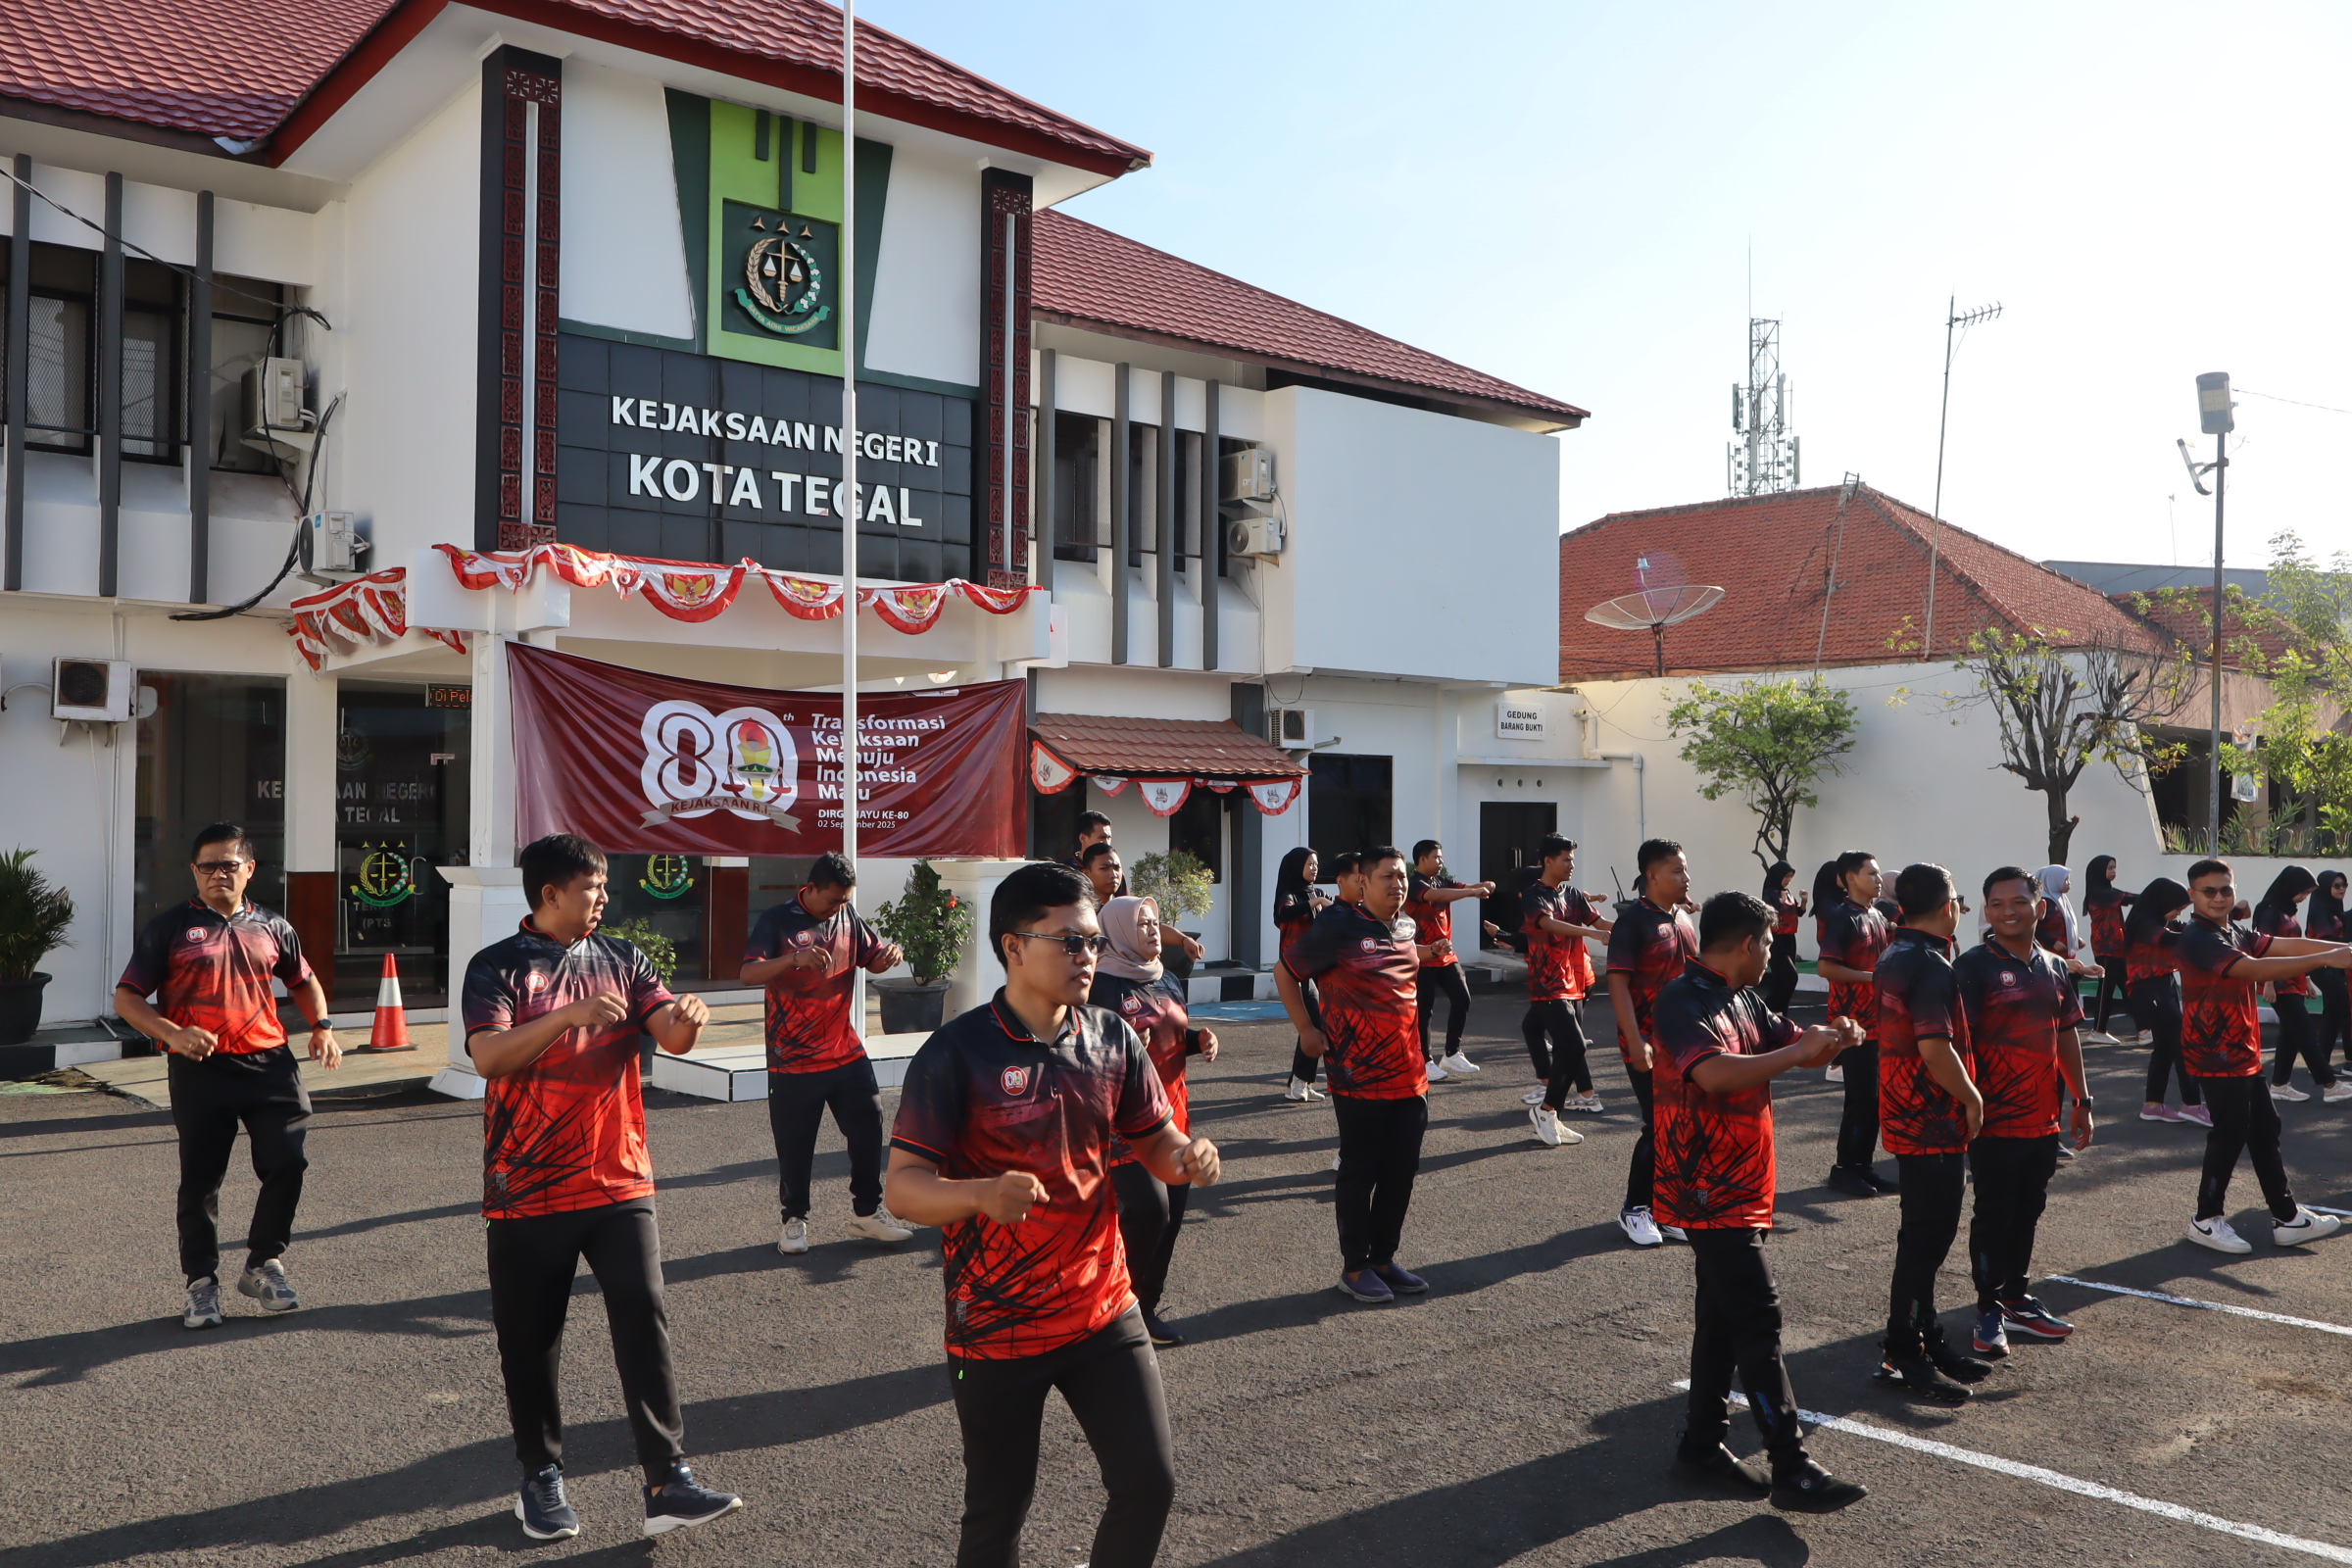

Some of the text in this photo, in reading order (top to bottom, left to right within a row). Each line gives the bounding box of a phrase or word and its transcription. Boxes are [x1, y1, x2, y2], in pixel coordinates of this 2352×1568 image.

[612, 396, 815, 451] KEJAKSAAN
[628, 454, 922, 527] KOTA TEGAL
[450, 690, 472, 703] Pel
[811, 713, 946, 730] Trasformasi
[1507, 710, 1538, 719] GEDUNG
[811, 731, 919, 750] Kejksaan
[817, 784, 870, 801] Mau
[671, 798, 750, 812] KEJAKSAAN
[818, 808, 909, 819] DIRGAYU KE-80
[830, 820, 875, 829] Sepmber
